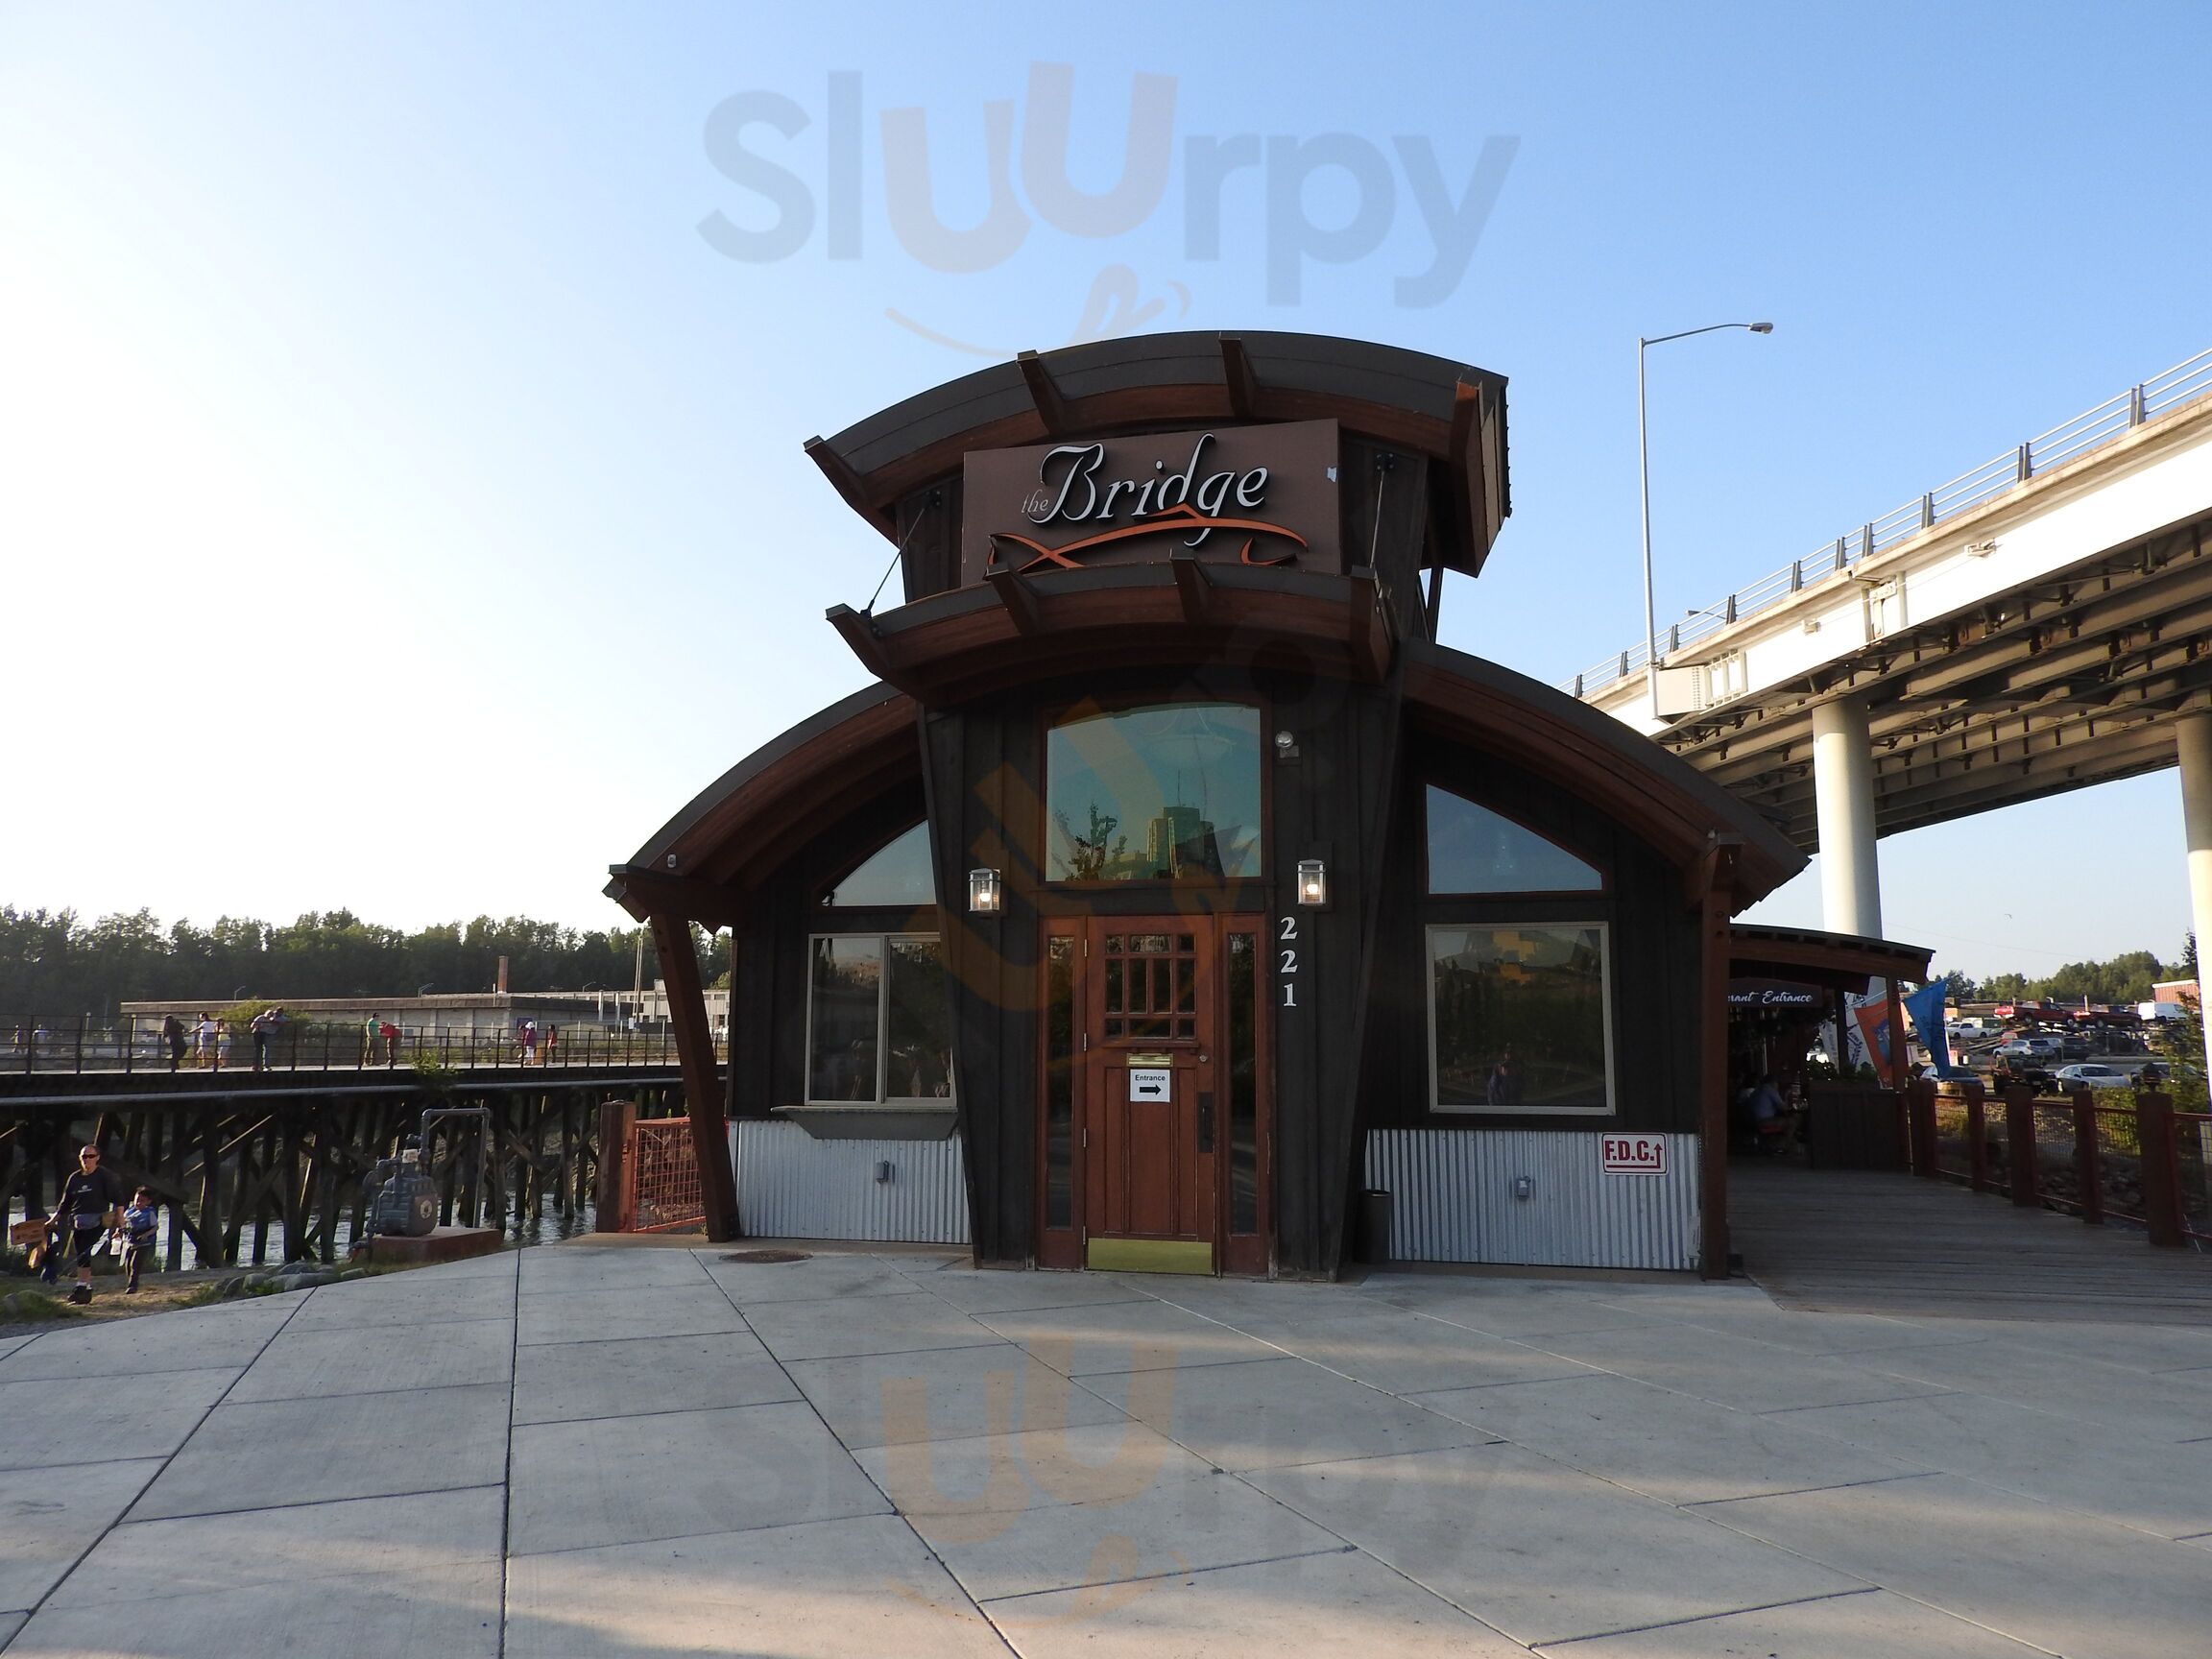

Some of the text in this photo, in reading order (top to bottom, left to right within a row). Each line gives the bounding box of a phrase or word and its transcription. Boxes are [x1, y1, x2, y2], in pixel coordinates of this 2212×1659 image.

[1022, 433, 1268, 546] the Bridge
[1280, 916, 1298, 1007] 221
[1762, 990, 1814, 1003] Entrance
[1604, 1140, 1654, 1161] F.D.C.
